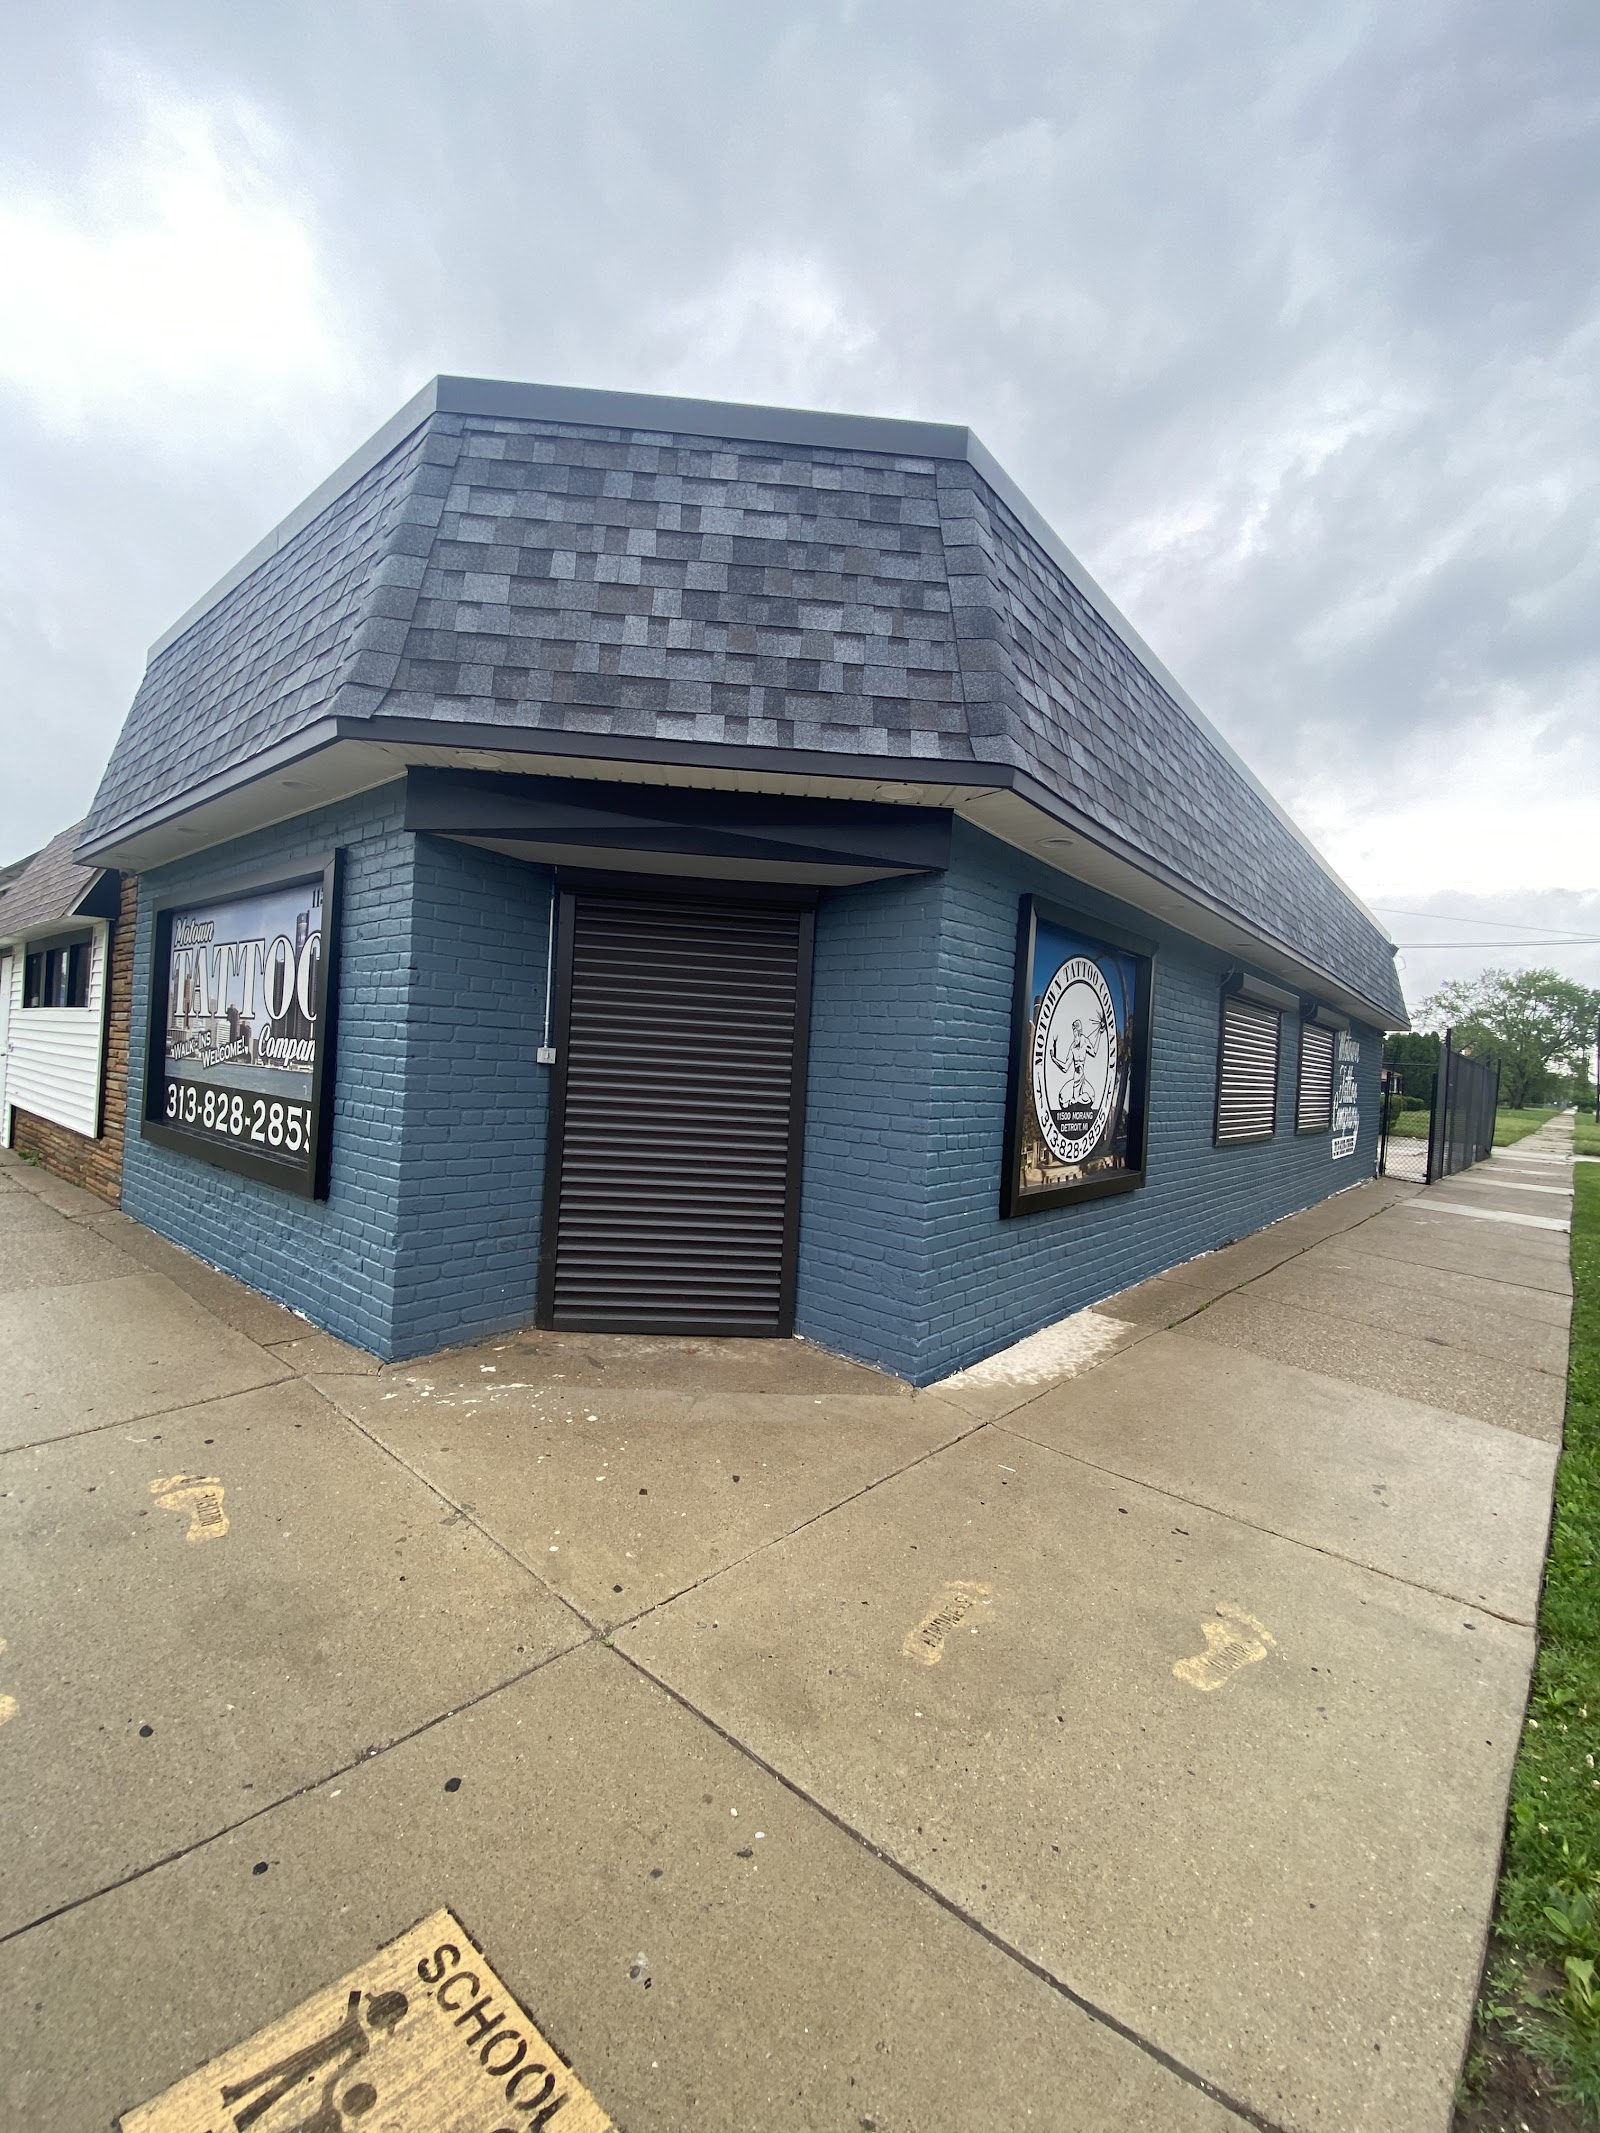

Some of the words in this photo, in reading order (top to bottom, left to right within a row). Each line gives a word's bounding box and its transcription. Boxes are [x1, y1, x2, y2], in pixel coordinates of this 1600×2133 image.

[174, 917, 214, 946] Motown
[1035, 979, 1062, 1067] MOTOWN
[1063, 960, 1099, 986] TATTOO
[1099, 982, 1116, 1070] COMPANY
[202, 1035, 245, 1068] WELCOME!
[1056, 1111, 1071, 1121] 11500
[1071, 1111, 1094, 1120] MORANG
[1041, 1108, 1106, 1159] 313-828-2855
